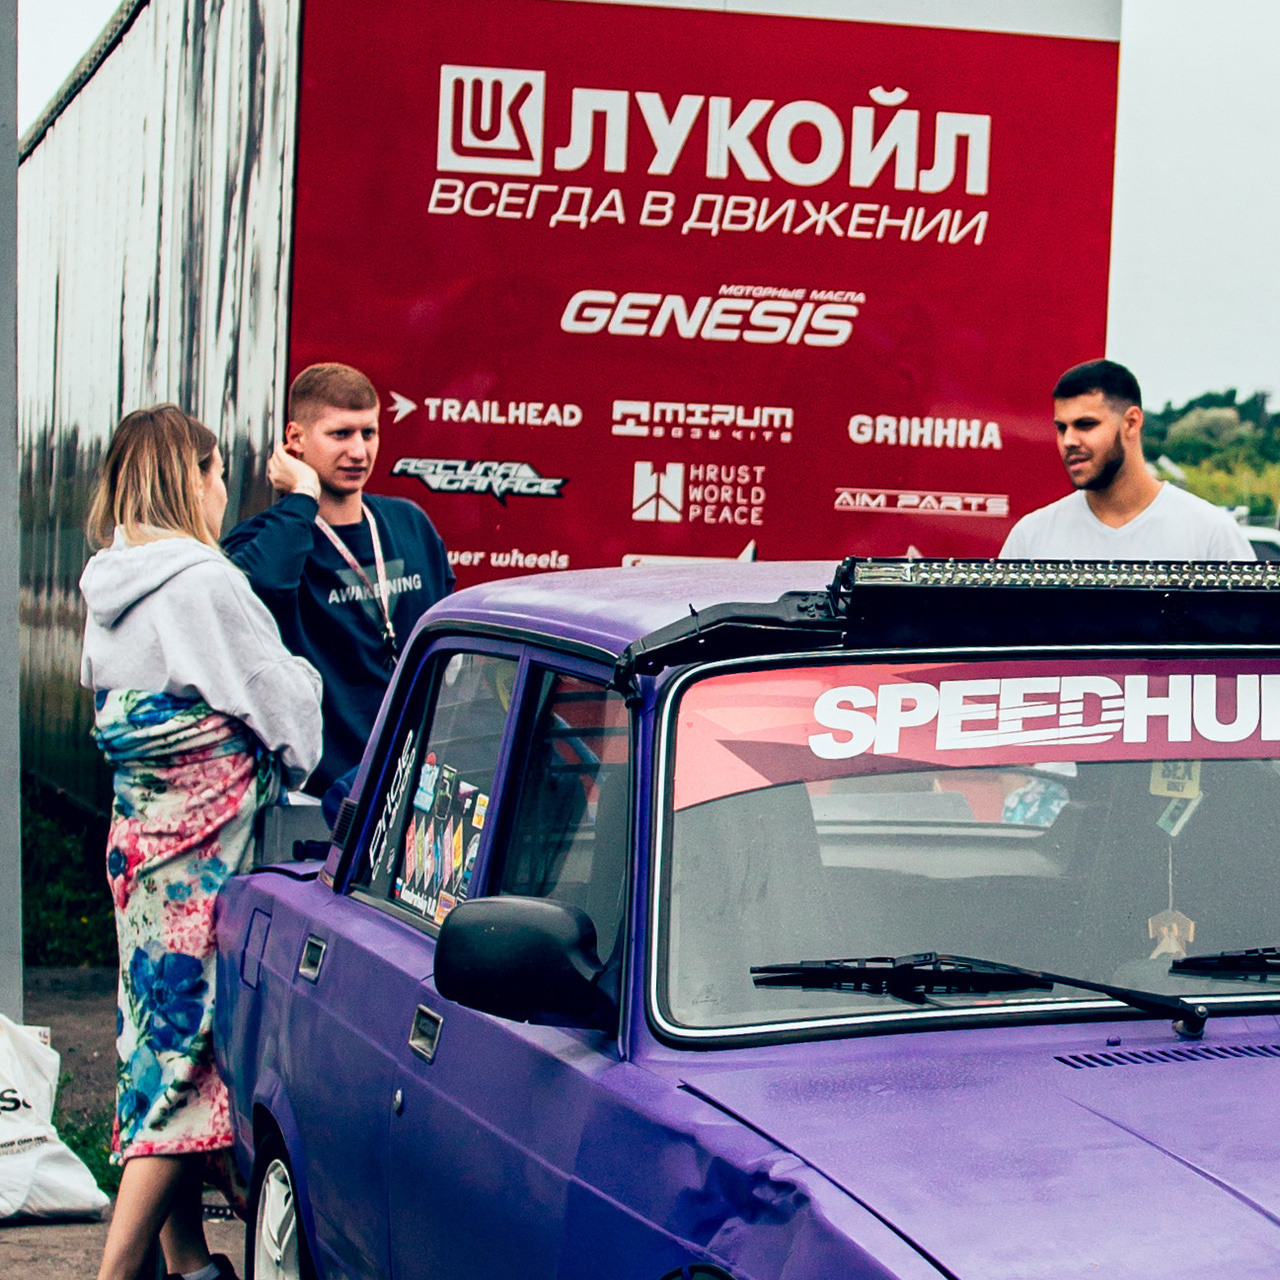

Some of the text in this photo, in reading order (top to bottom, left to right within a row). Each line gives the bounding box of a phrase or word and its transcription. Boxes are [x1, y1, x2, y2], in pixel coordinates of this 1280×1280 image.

[554, 85, 991, 196] ЛУКОЙЛ
[428, 178, 989, 246] ВСЕГДА В ДВИЖЕНИИ
[718, 284, 867, 304] МОТОРНЫЕ МАСЛА
[560, 289, 859, 347] GENESIS
[424, 397, 583, 427] TRAILHEAD
[690, 464, 766, 485] HRUST
[688, 484, 767, 505] WORLD
[835, 491, 1010, 516] AIM PARTS
[688, 504, 764, 526] PEACE
[490, 548, 570, 569] wheels
